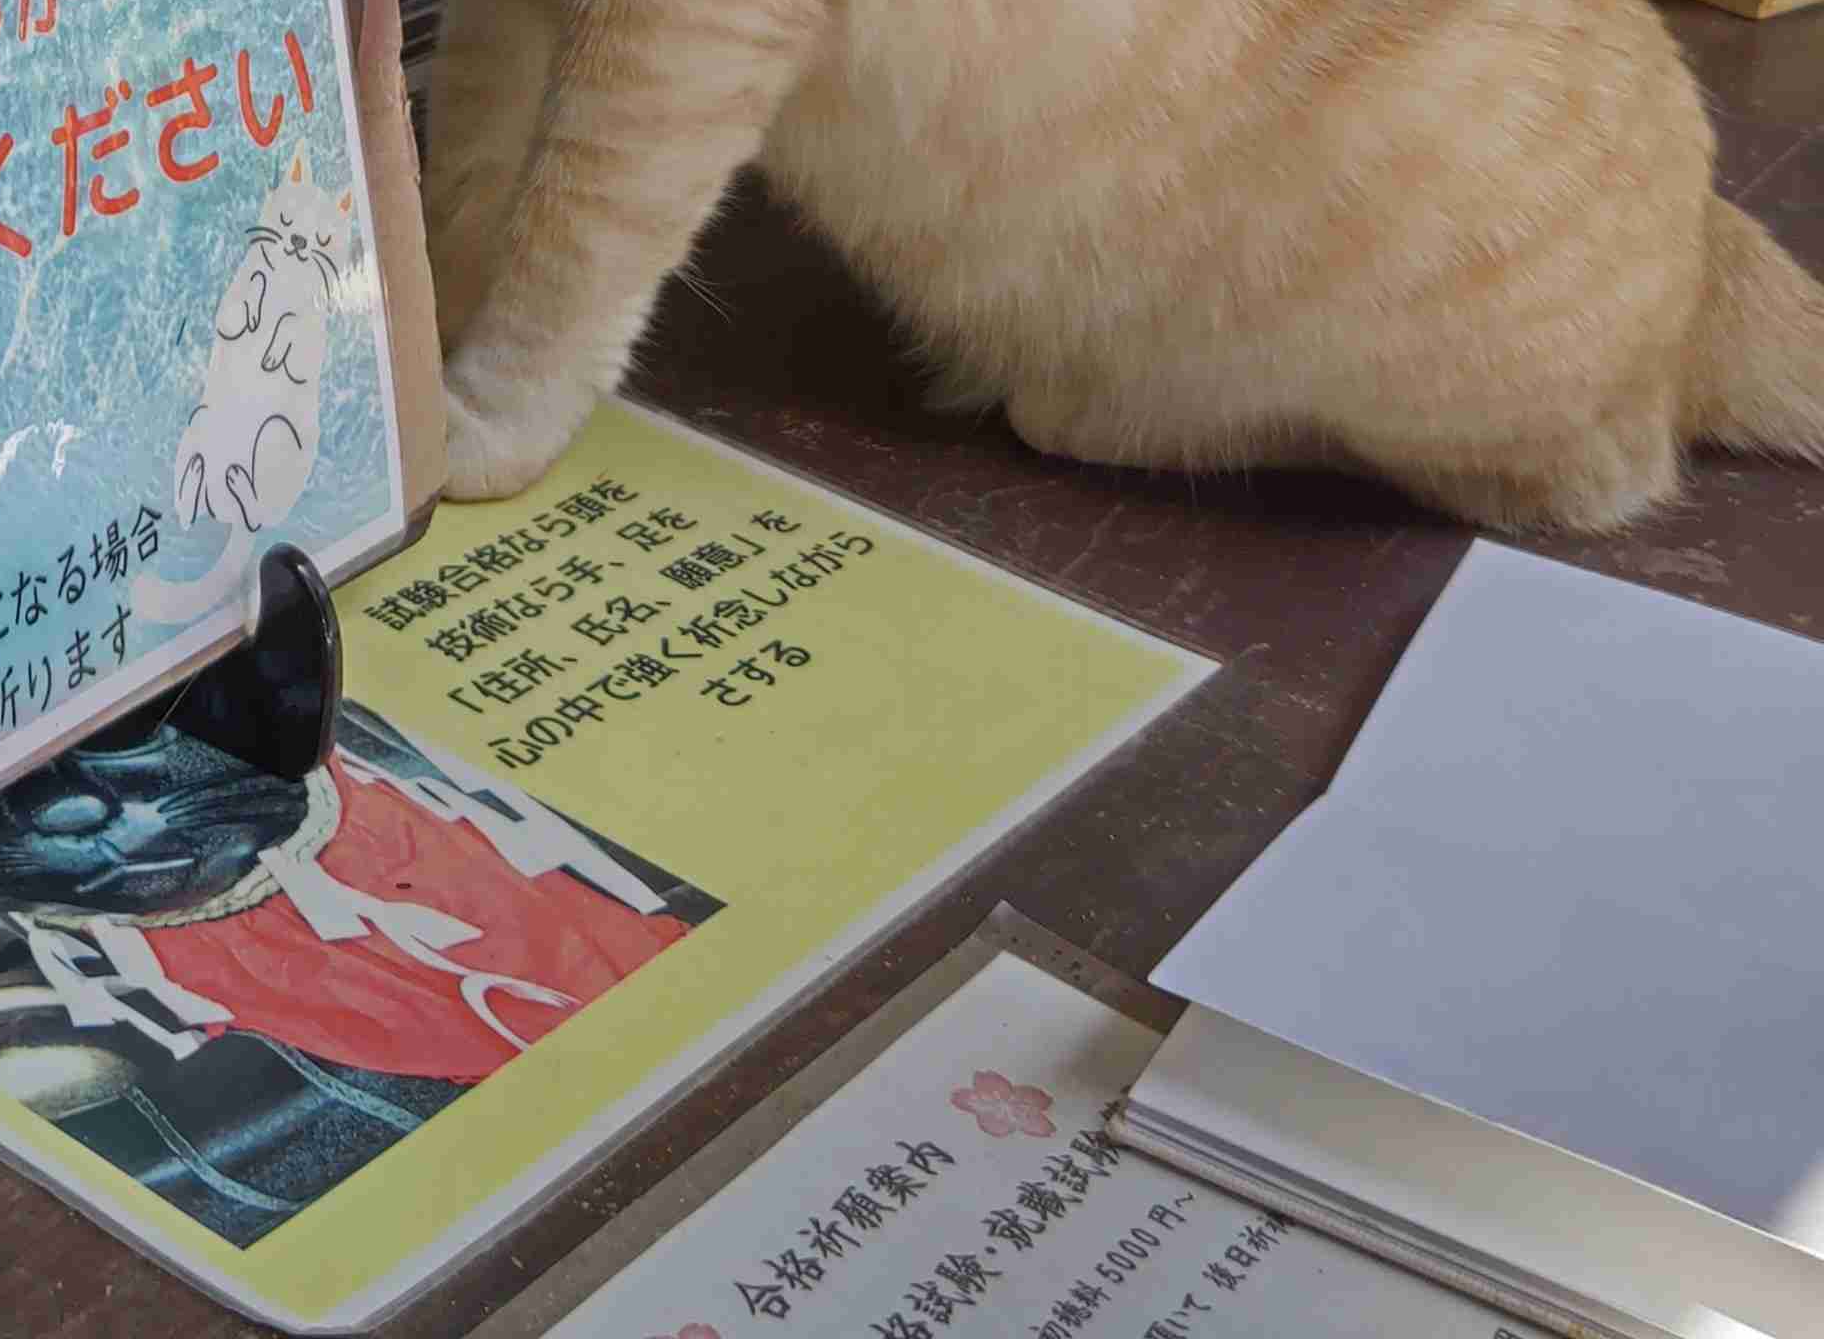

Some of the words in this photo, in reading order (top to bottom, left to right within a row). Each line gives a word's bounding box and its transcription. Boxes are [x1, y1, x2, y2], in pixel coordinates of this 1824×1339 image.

[362, 477, 640, 633] 試験合格なら頭を
[424, 505, 700, 664] 技術なら手、足を
[446, 508, 803, 715] 「住所、氏名、願意」を
[487, 529, 876, 771] 心の中で強く祈念しながら
[700, 638, 813, 708] さする
[733, 1139, 956, 1322] 合格祈願案内
